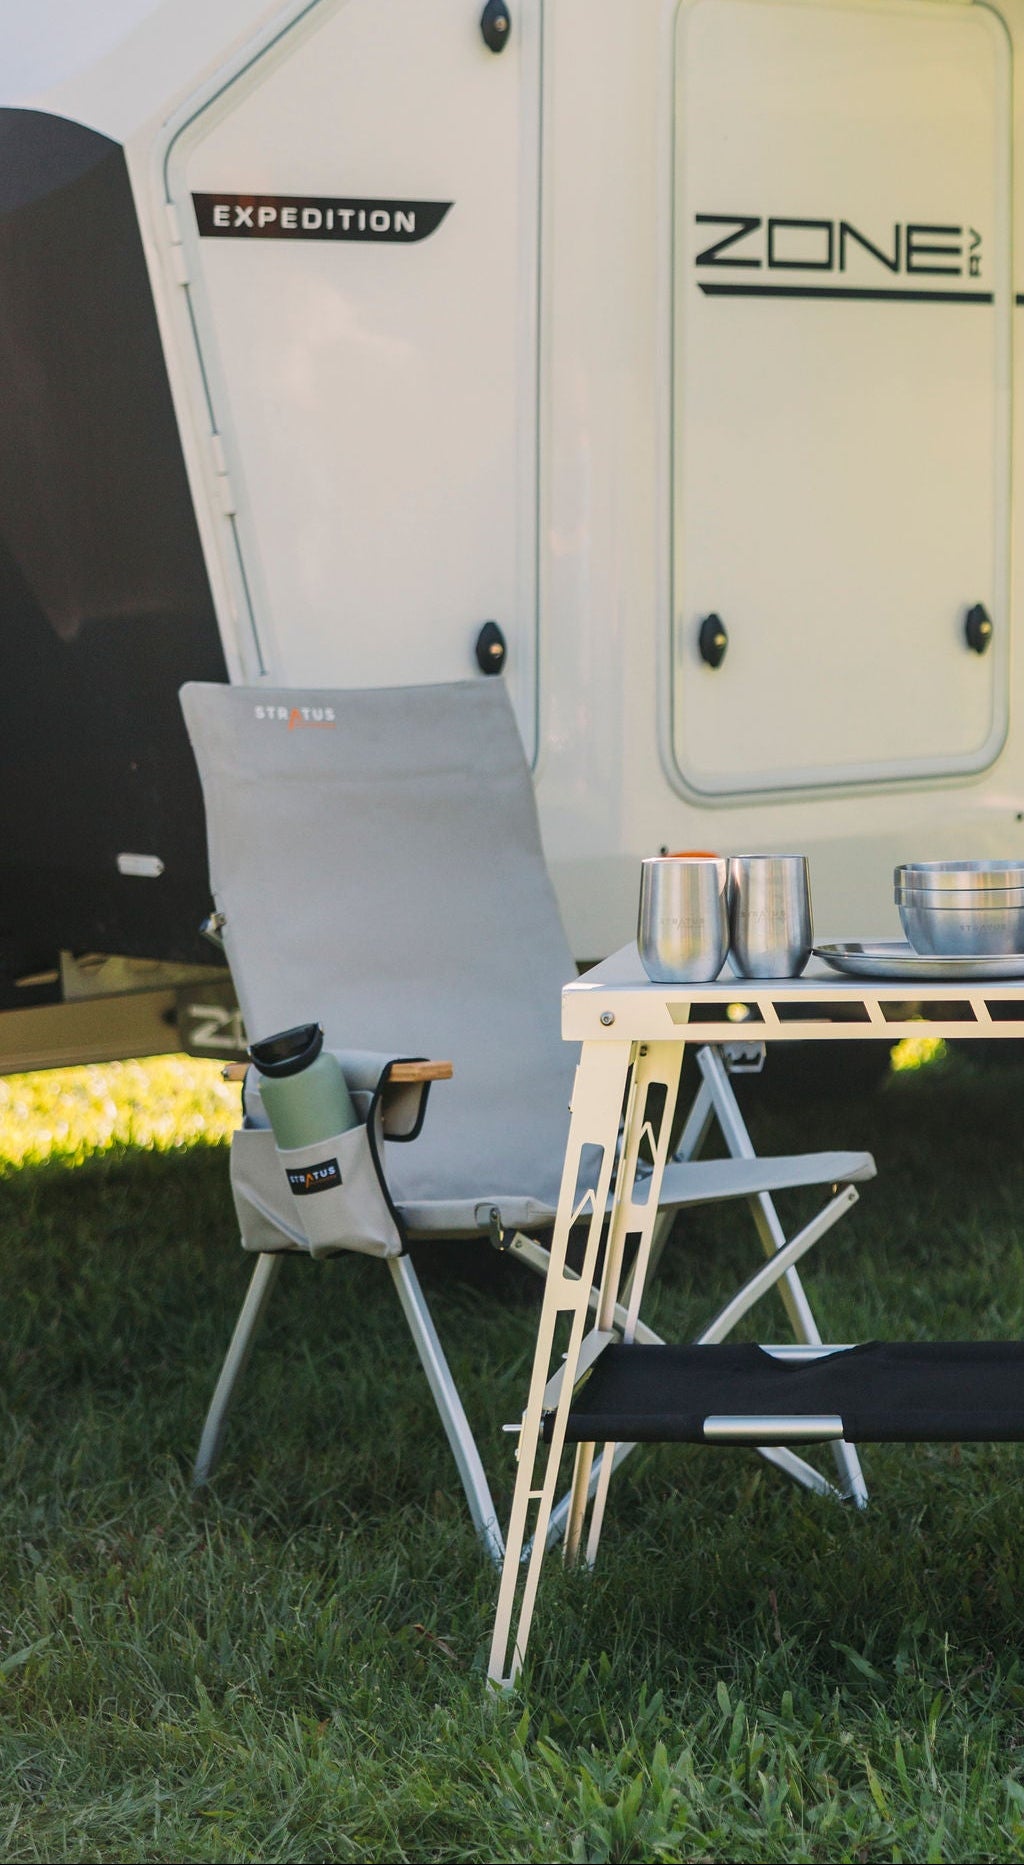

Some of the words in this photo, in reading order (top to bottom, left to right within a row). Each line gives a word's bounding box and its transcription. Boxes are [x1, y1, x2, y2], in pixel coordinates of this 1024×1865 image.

[212, 204, 416, 233] EXPEDITION
[695, 213, 962, 275] ZONE
[254, 705, 336, 731] STRATUS
[290, 1166, 335, 1189] STRATUS
